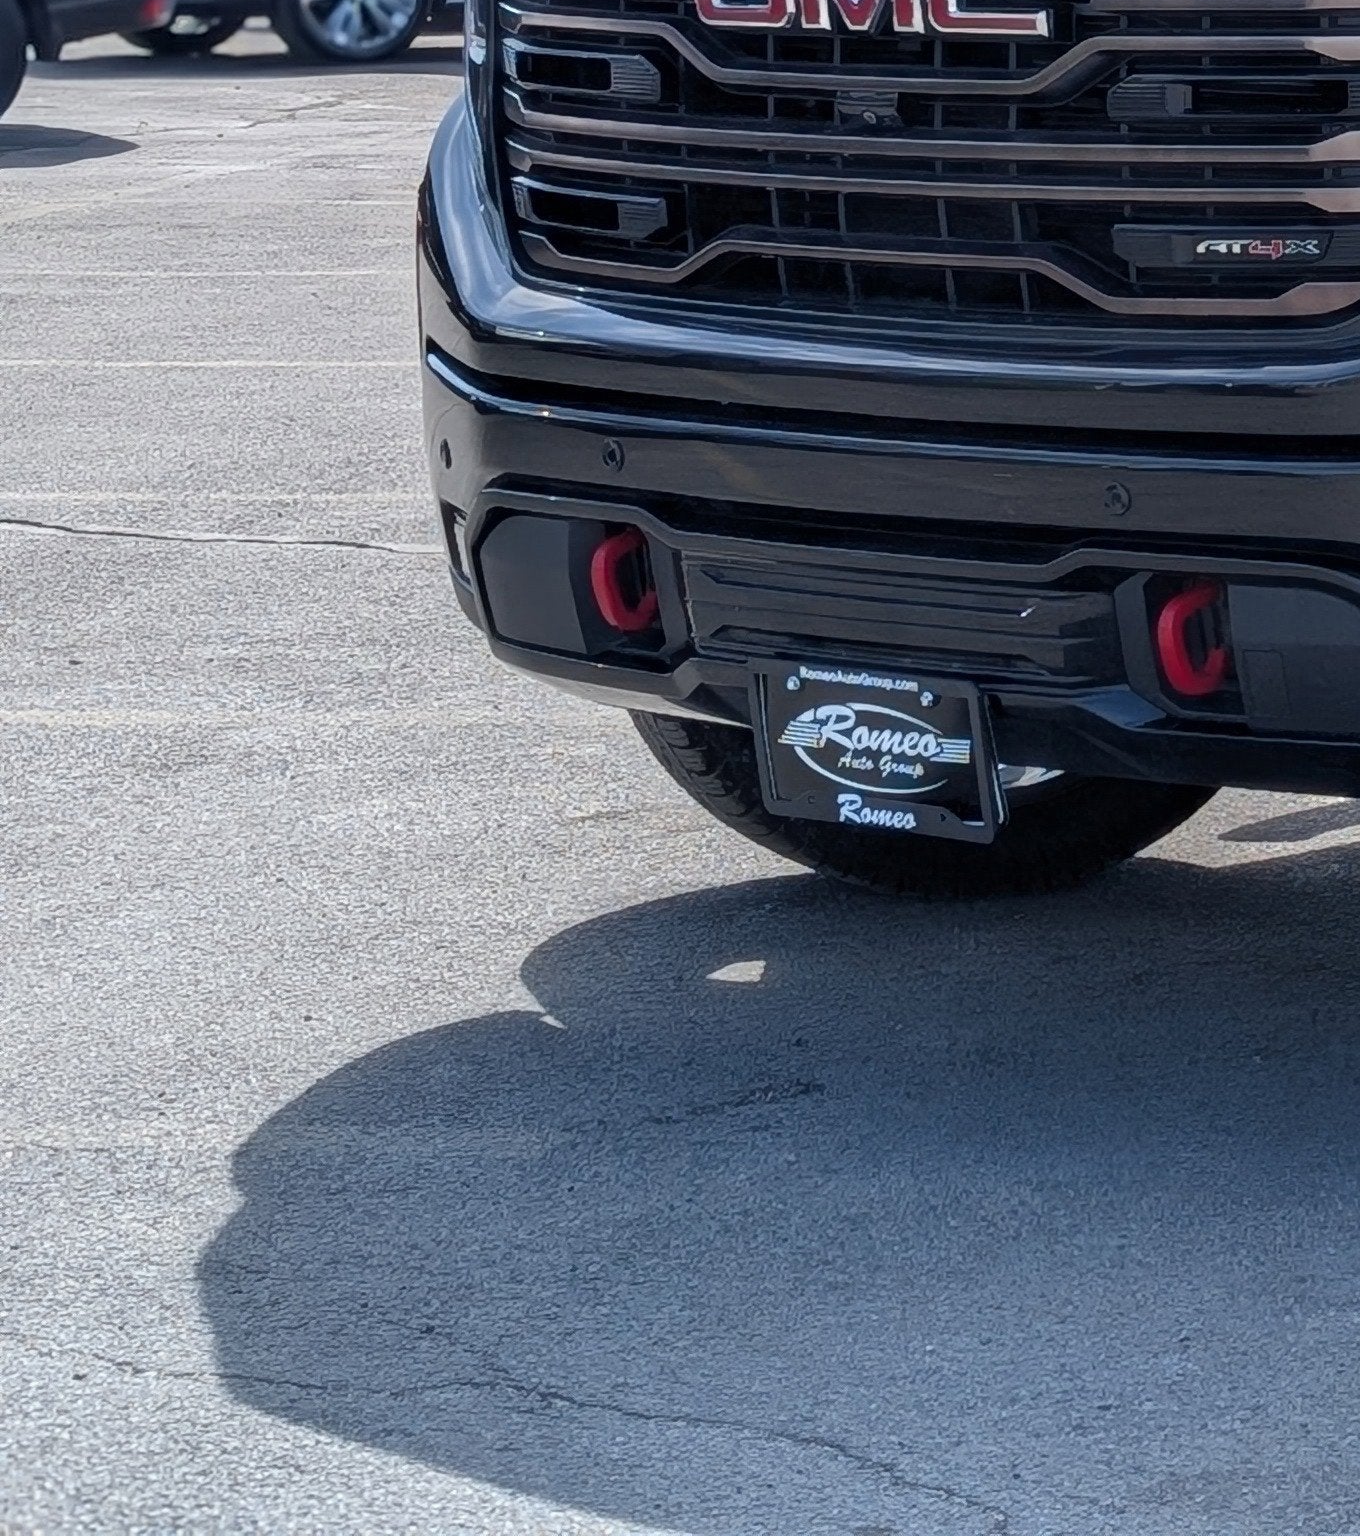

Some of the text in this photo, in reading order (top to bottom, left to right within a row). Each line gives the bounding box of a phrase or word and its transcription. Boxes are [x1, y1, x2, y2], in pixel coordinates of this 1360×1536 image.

[1196, 238, 1320, 260] AT4X
[816, 704, 940, 758] Romeo
[878, 755, 925, 779] Group
[837, 793, 917, 830] Romeo
